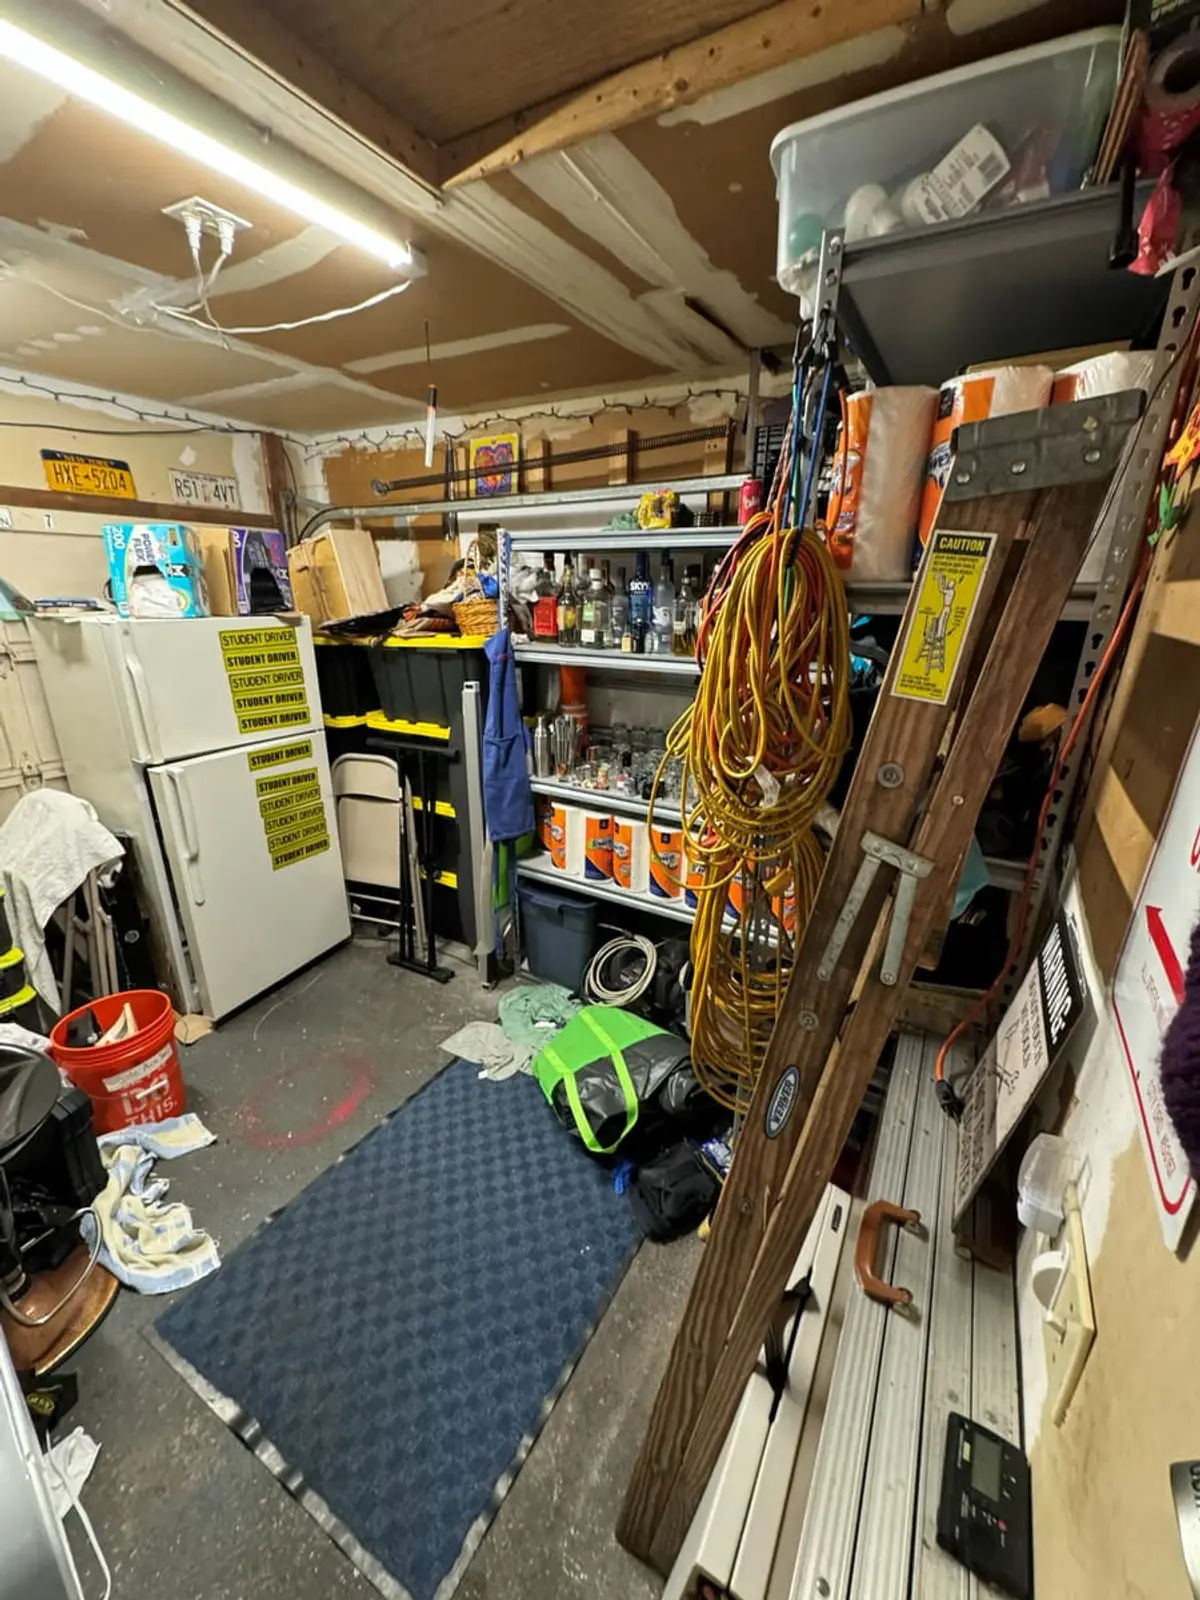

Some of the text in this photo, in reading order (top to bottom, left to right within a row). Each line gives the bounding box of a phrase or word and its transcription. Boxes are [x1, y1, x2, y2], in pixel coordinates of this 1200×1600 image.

[213, 482, 236, 502] 4VT
[939, 536, 985, 551] CAUTION
[222, 629, 295, 646] STUDENT DRIVER
[227, 652, 296, 667] STUDENT DRIVER
[232, 671, 301, 688] STUDENT DRIVER
[236, 692, 304, 708] STUDENT DRIVER
[241, 712, 307, 729] STUDENT DRIVER
[251, 746, 310, 766] STUDENT DRIVER
[259, 773, 316, 792] STUDENT DRIVER
[262, 790, 321, 813] STUDENT DRIVER
[266, 807, 324, 830] STUDENT DRIVER
[270, 824, 327, 848] STUDENT DRIVER
[275, 838, 329, 866] STUDENT DRIVER
